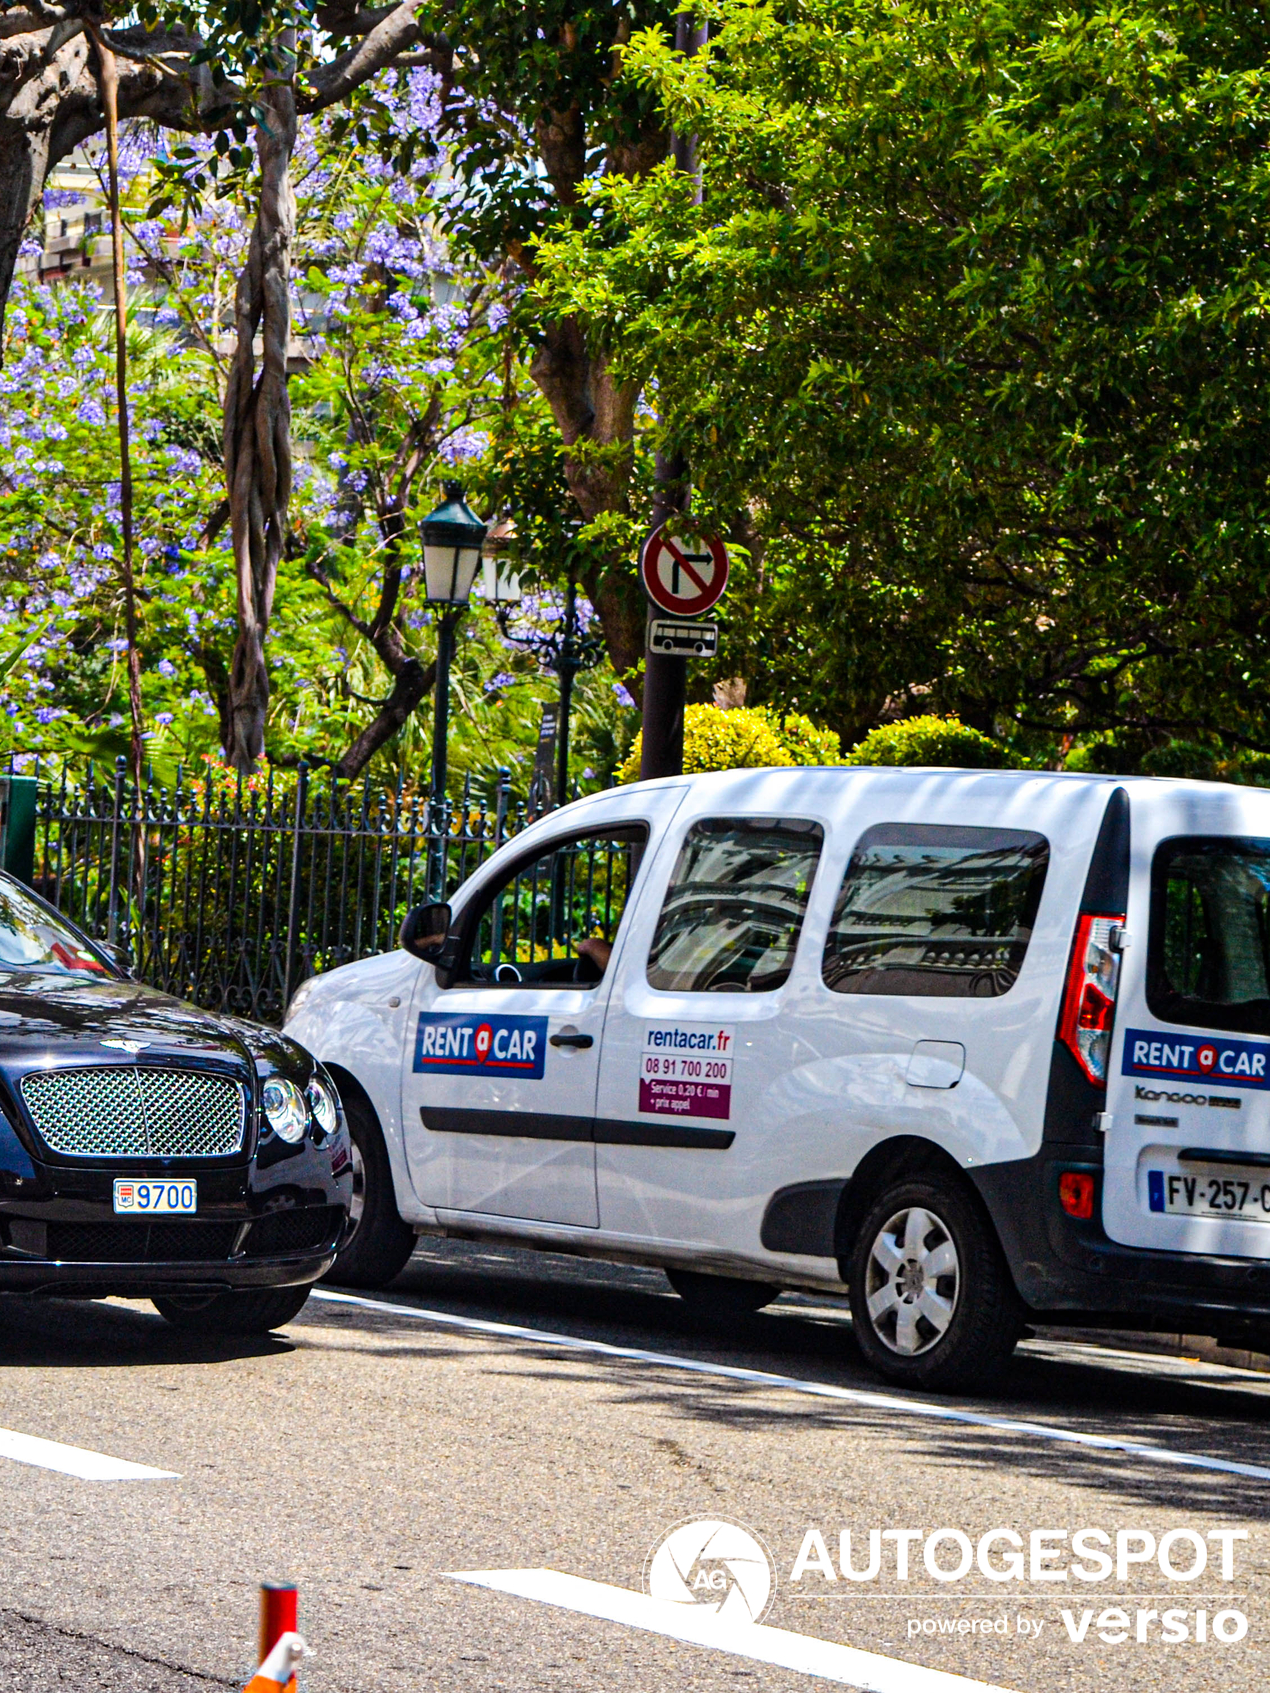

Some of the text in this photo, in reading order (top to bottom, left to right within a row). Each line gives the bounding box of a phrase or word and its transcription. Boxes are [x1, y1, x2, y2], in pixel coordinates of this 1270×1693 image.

[422, 1026, 473, 1057] RENT
[493, 1028, 537, 1060] CAR
[647, 1028, 730, 1051] rentacar.fr
[646, 1058, 727, 1079] 08 91 700 200
[1133, 1040, 1194, 1068] RENT
[1219, 1050, 1266, 1076] CAR
[651, 1081, 677, 1095] Service
[1134, 1084, 1208, 1106] Kangoo
[655, 1097, 670, 1111] prix
[671, 1098, 691, 1112] appel
[137, 1184, 194, 1209] 9700
